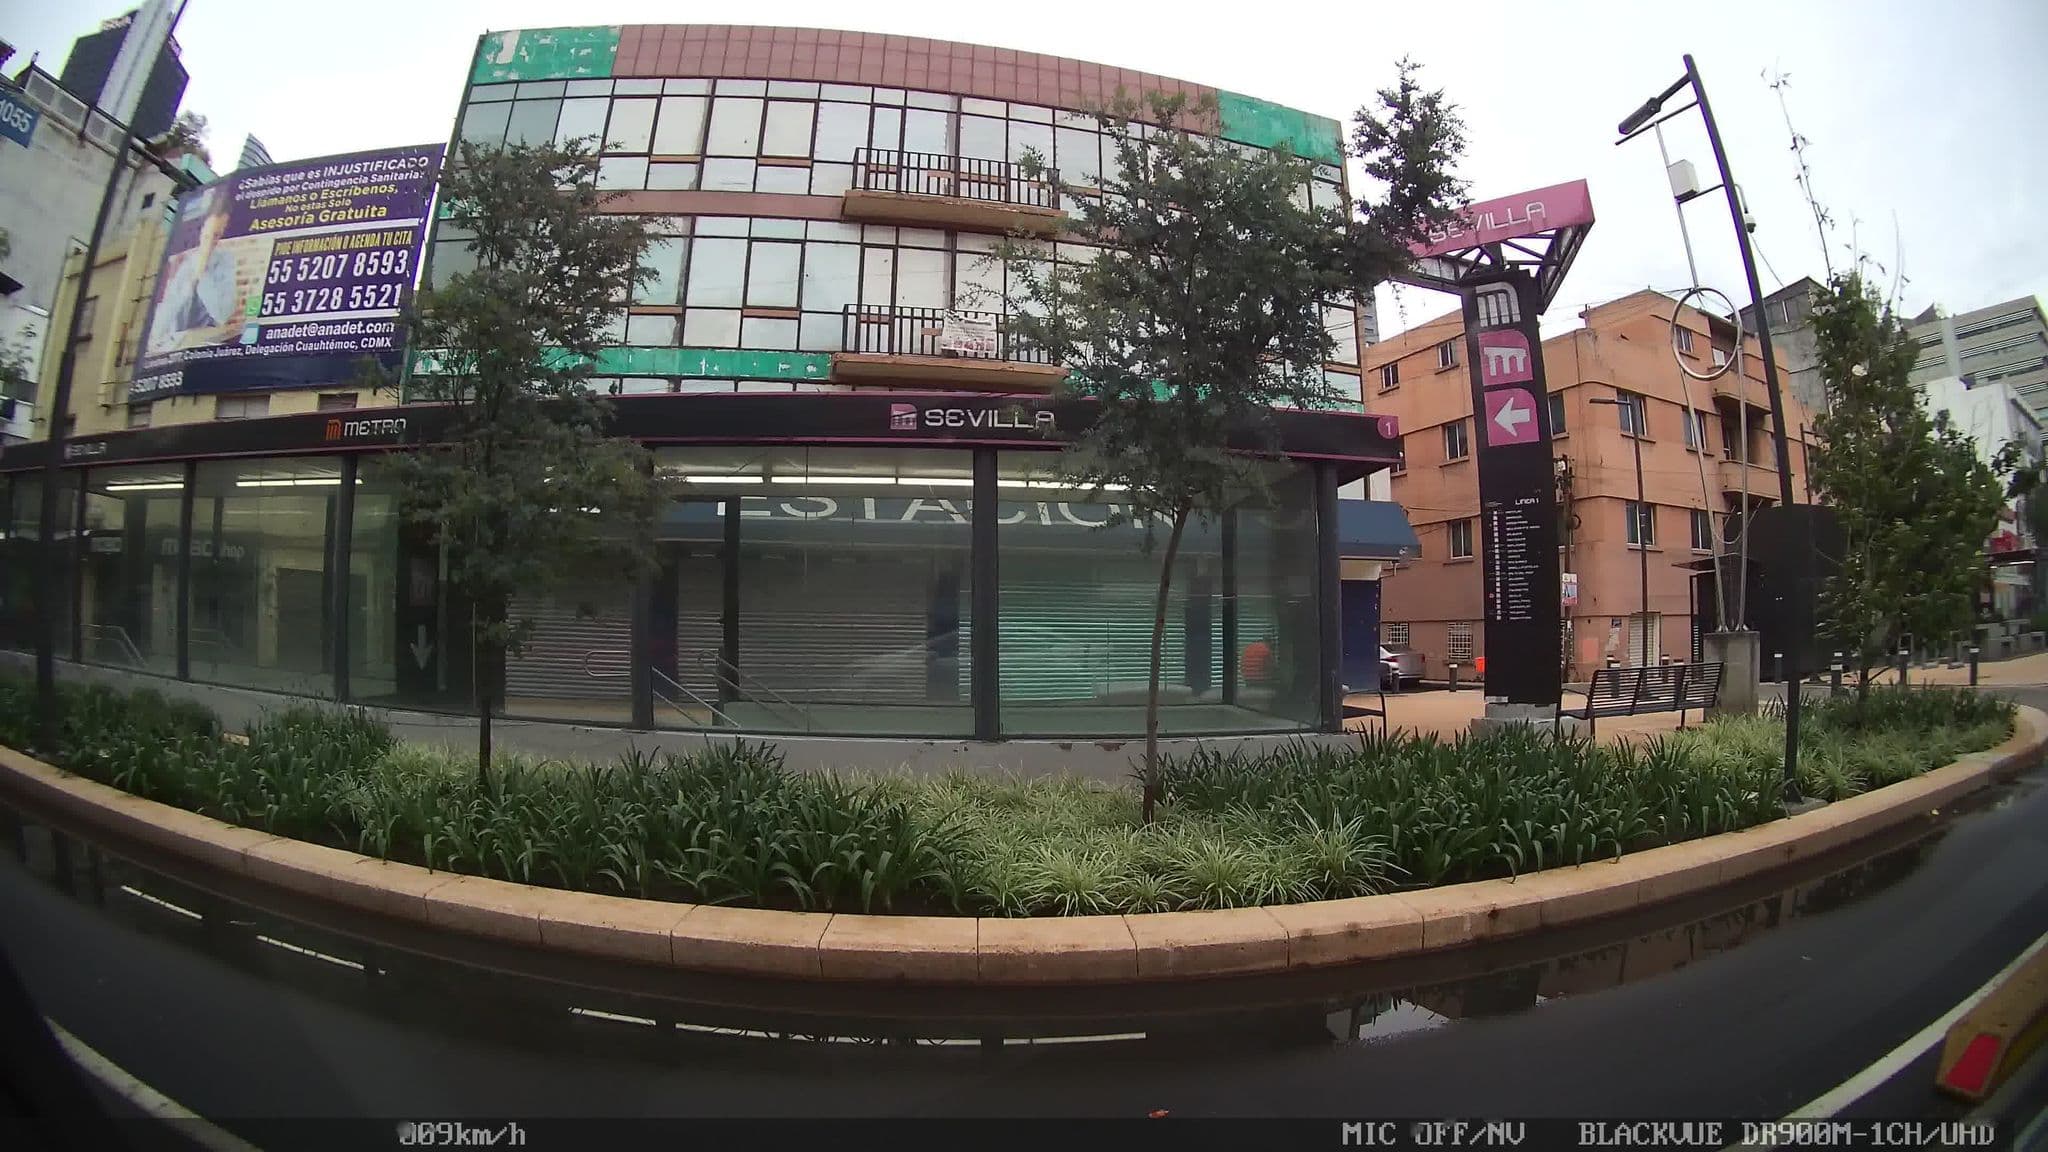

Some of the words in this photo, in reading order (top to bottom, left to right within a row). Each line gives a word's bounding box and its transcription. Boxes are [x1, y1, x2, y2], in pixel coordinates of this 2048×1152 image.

[283, 171, 305, 184] que
[307, 169, 321, 179] es
[323, 157, 428, 177] INJUSTIFICADO
[282, 184, 300, 195] por
[302, 175, 369, 191] Contingencia
[285, 204, 299, 213] No
[328, 198, 352, 208] Solo
[309, 192, 318, 201] o
[250, 210, 314, 231] Asesoría
[319, 205, 388, 223] Gratuita
[342, 235, 349, 249] O
[349, 231, 380, 248] AGENDA
[382, 231, 393, 246] TU
[393, 230, 412, 245] CITA
[268, 259, 293, 284] 55
[296, 254, 349, 281] 5207
[353, 249, 408, 277] 8593
[262, 292, 287, 315] 55
[291, 286, 343, 312] 3728
[349, 283, 403, 309] 5521
[265, 322, 395, 340] anadet@anadet.com
[245, 341, 294, 355] Delegación
[296, 338, 358, 353] Cuauhtémoc,
[361, 336, 392, 348] CDMX
[344, 418, 407, 436] METRO
[924, 409, 1055, 429] SEVILLA
[1385, 422, 1392, 436] 1
